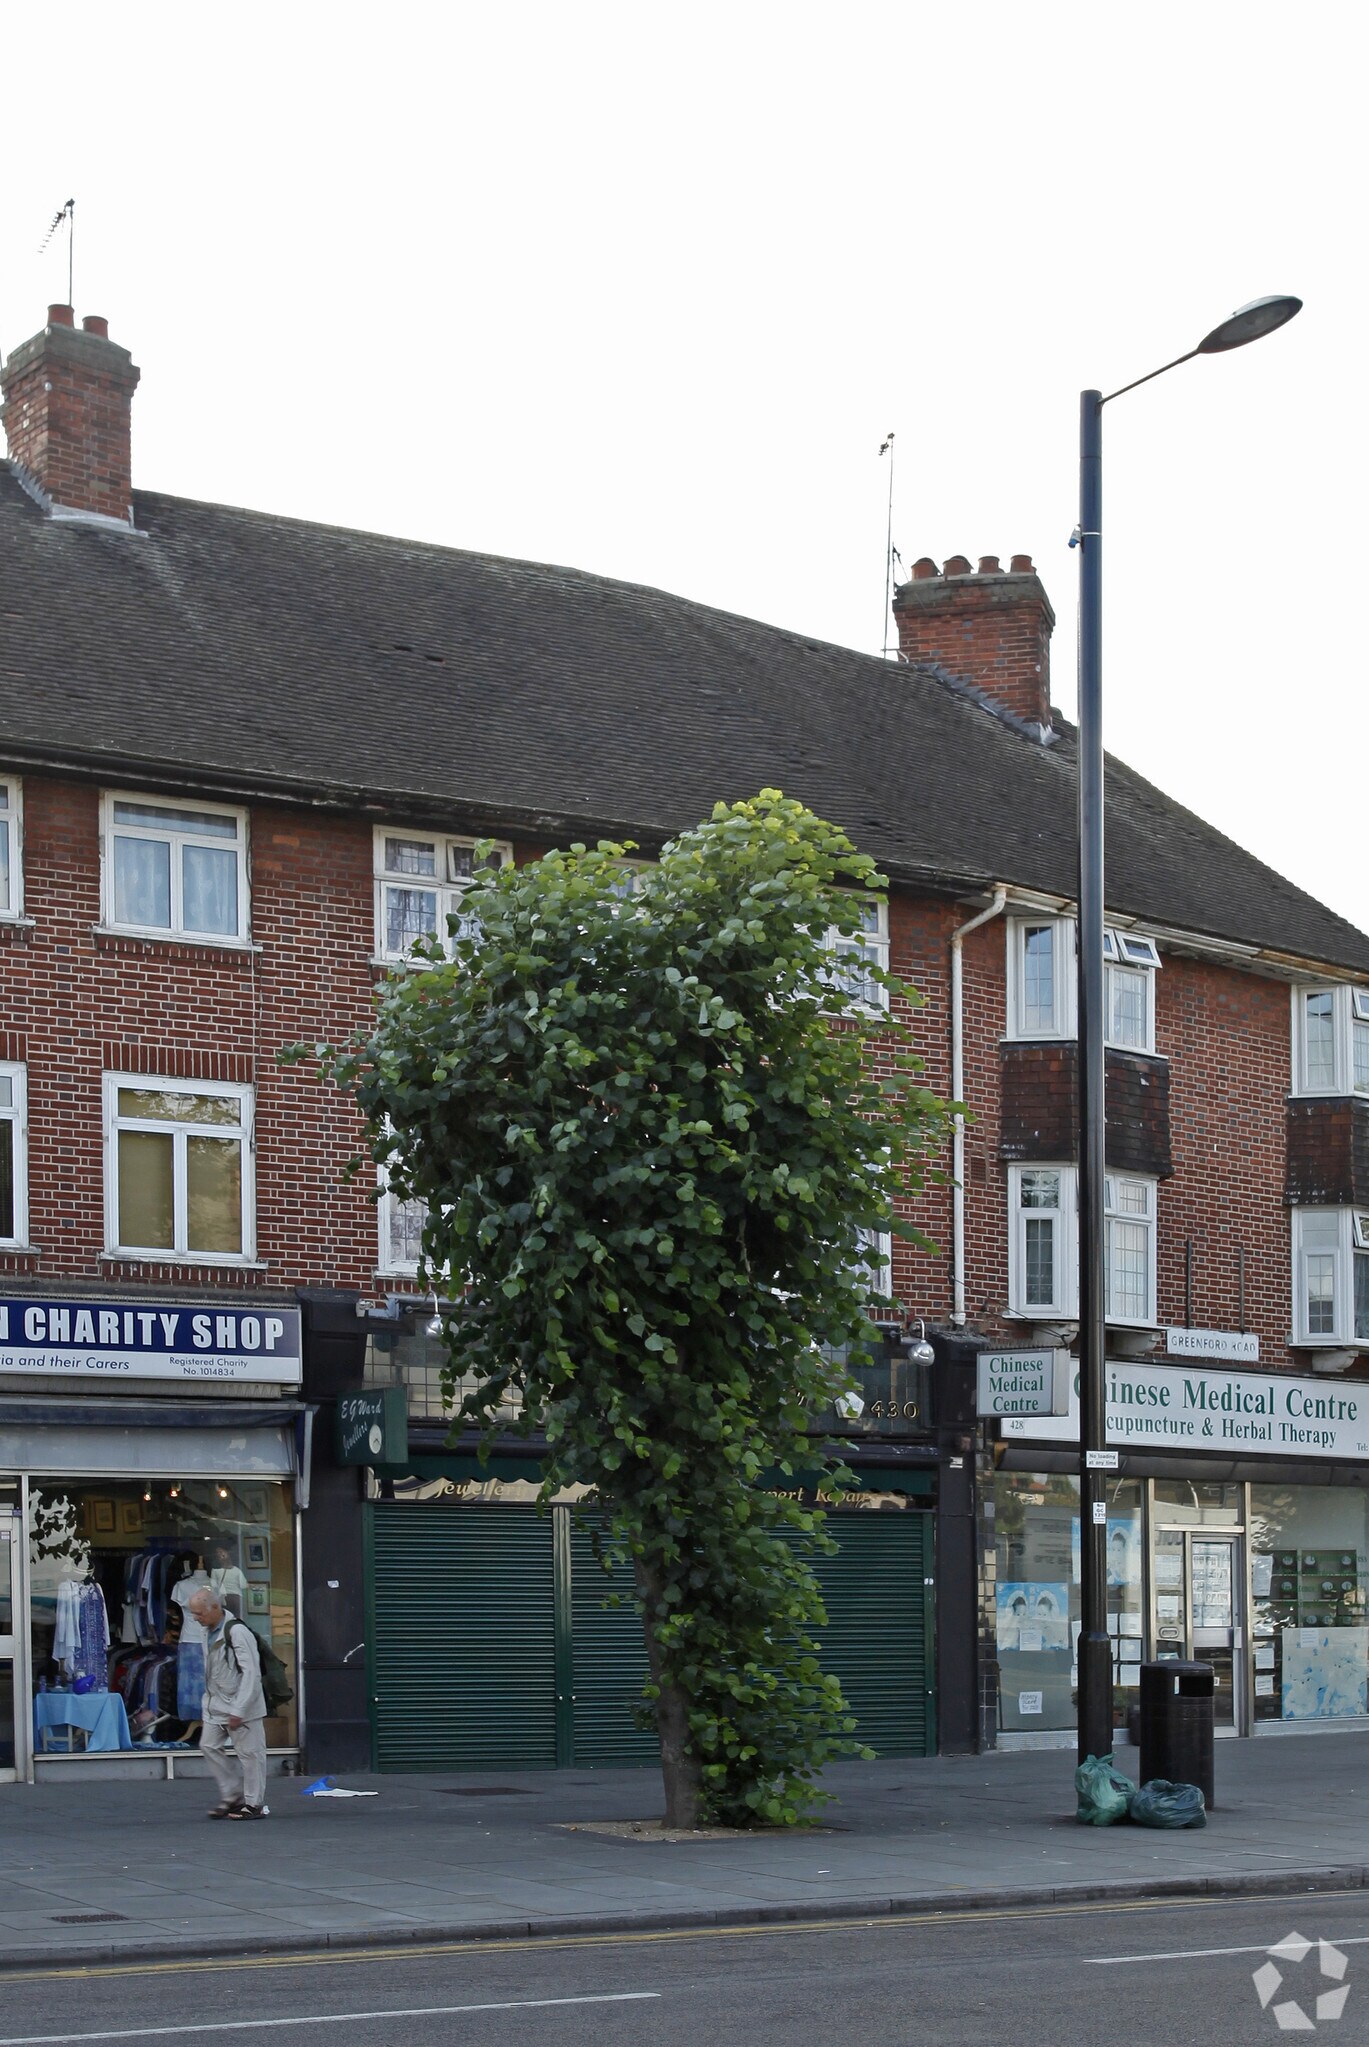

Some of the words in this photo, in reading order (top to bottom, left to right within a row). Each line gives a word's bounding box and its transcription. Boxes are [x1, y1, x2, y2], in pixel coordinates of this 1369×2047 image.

[24, 1306, 180, 1347] CHARITY
[191, 1314, 284, 1351] SHOP
[1171, 1335, 1228, 1351] GREENFORD
[18, 1355, 46, 1367] and
[50, 1355, 81, 1368] their
[86, 1356, 130, 1370] Carers
[169, 1356, 214, 1367] Registered
[216, 1358, 248, 1368] Charity
[989, 1357, 1043, 1374] Chinese
[200, 1368, 235, 1376] 1014834
[988, 1375, 1044, 1393] Medical
[992, 1396, 1039, 1412] Centre
[1182, 1379, 1275, 1415] Medical
[1286, 1388, 1358, 1421] Centre
[870, 1400, 920, 1419] 430
[1010, 1420, 1024, 1430] 428
[1106, 1415, 1195, 1436] cupuncture
[1201, 1417, 1214, 1436] &
[1222, 1418, 1272, 1441] Herbal
[1279, 1422, 1337, 1449] Therapy
